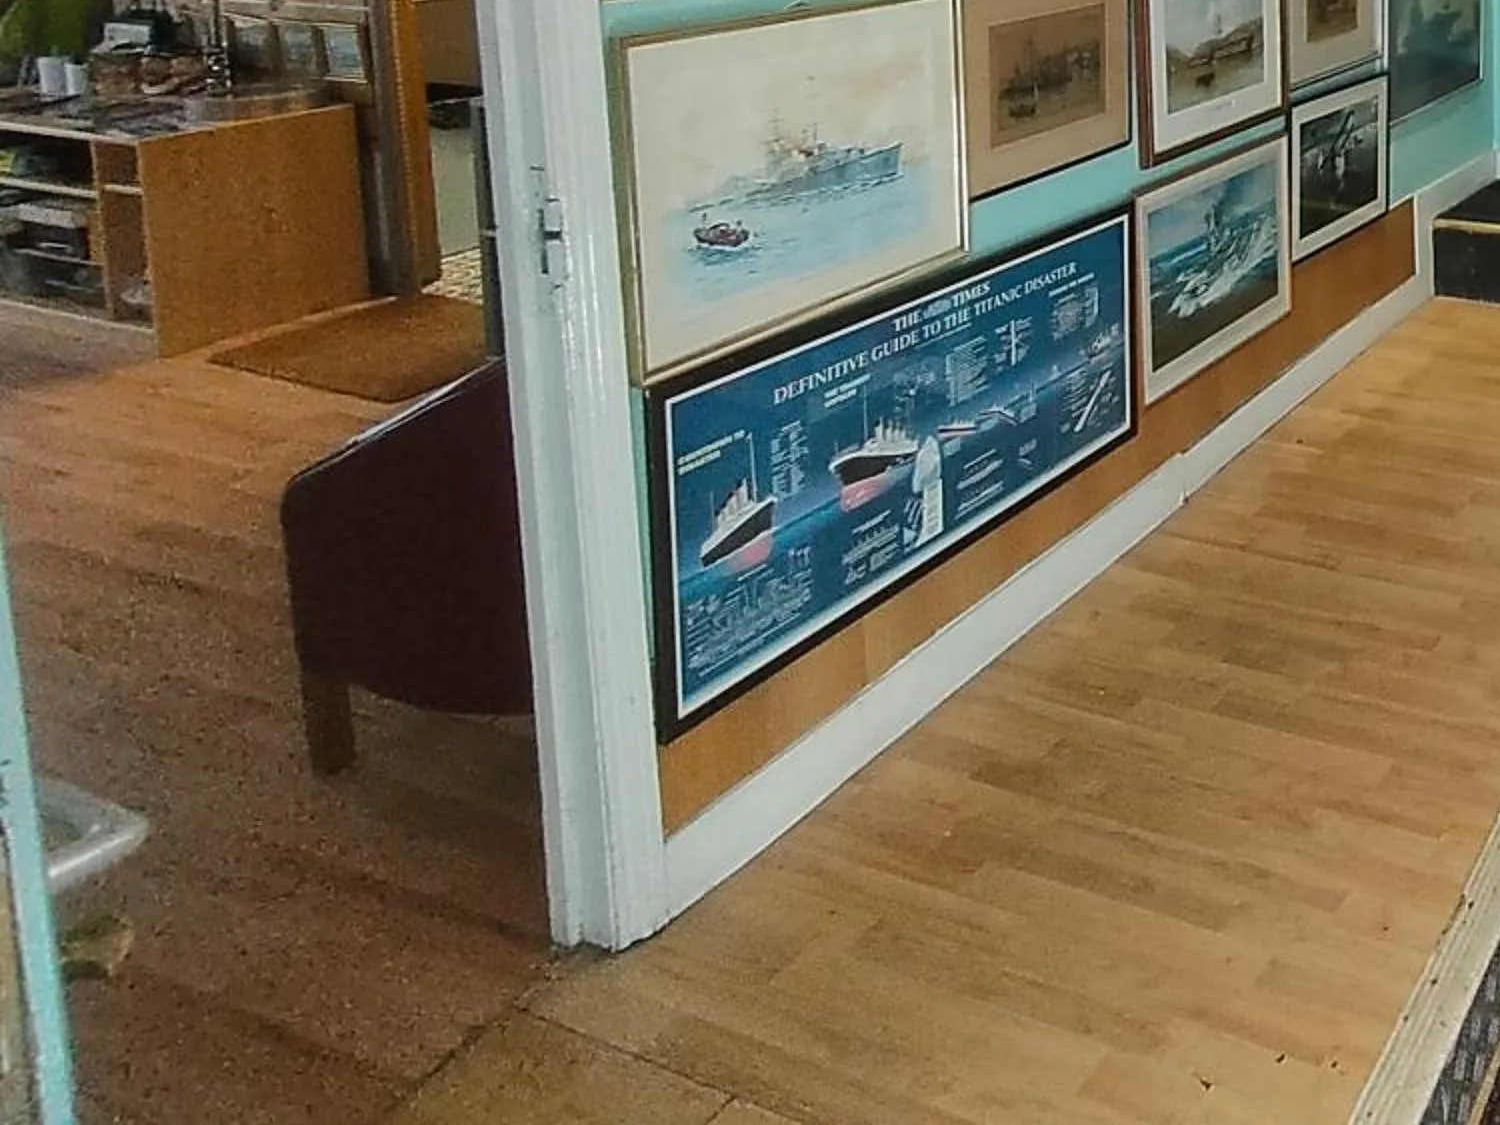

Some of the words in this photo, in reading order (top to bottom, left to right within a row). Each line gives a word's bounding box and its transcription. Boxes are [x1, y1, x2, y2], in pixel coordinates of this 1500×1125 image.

[773, 351, 869, 406] DEFINITIVE
[871, 331, 919, 361] GUIDE
[922, 321, 942, 339] TO
[944, 310, 973, 333] THE
[974, 285, 1023, 316] TITANIC
[1024, 262, 1078, 300] DISASTER
[893, 310, 924, 333] THE
[951, 281, 991, 308] TIMES
